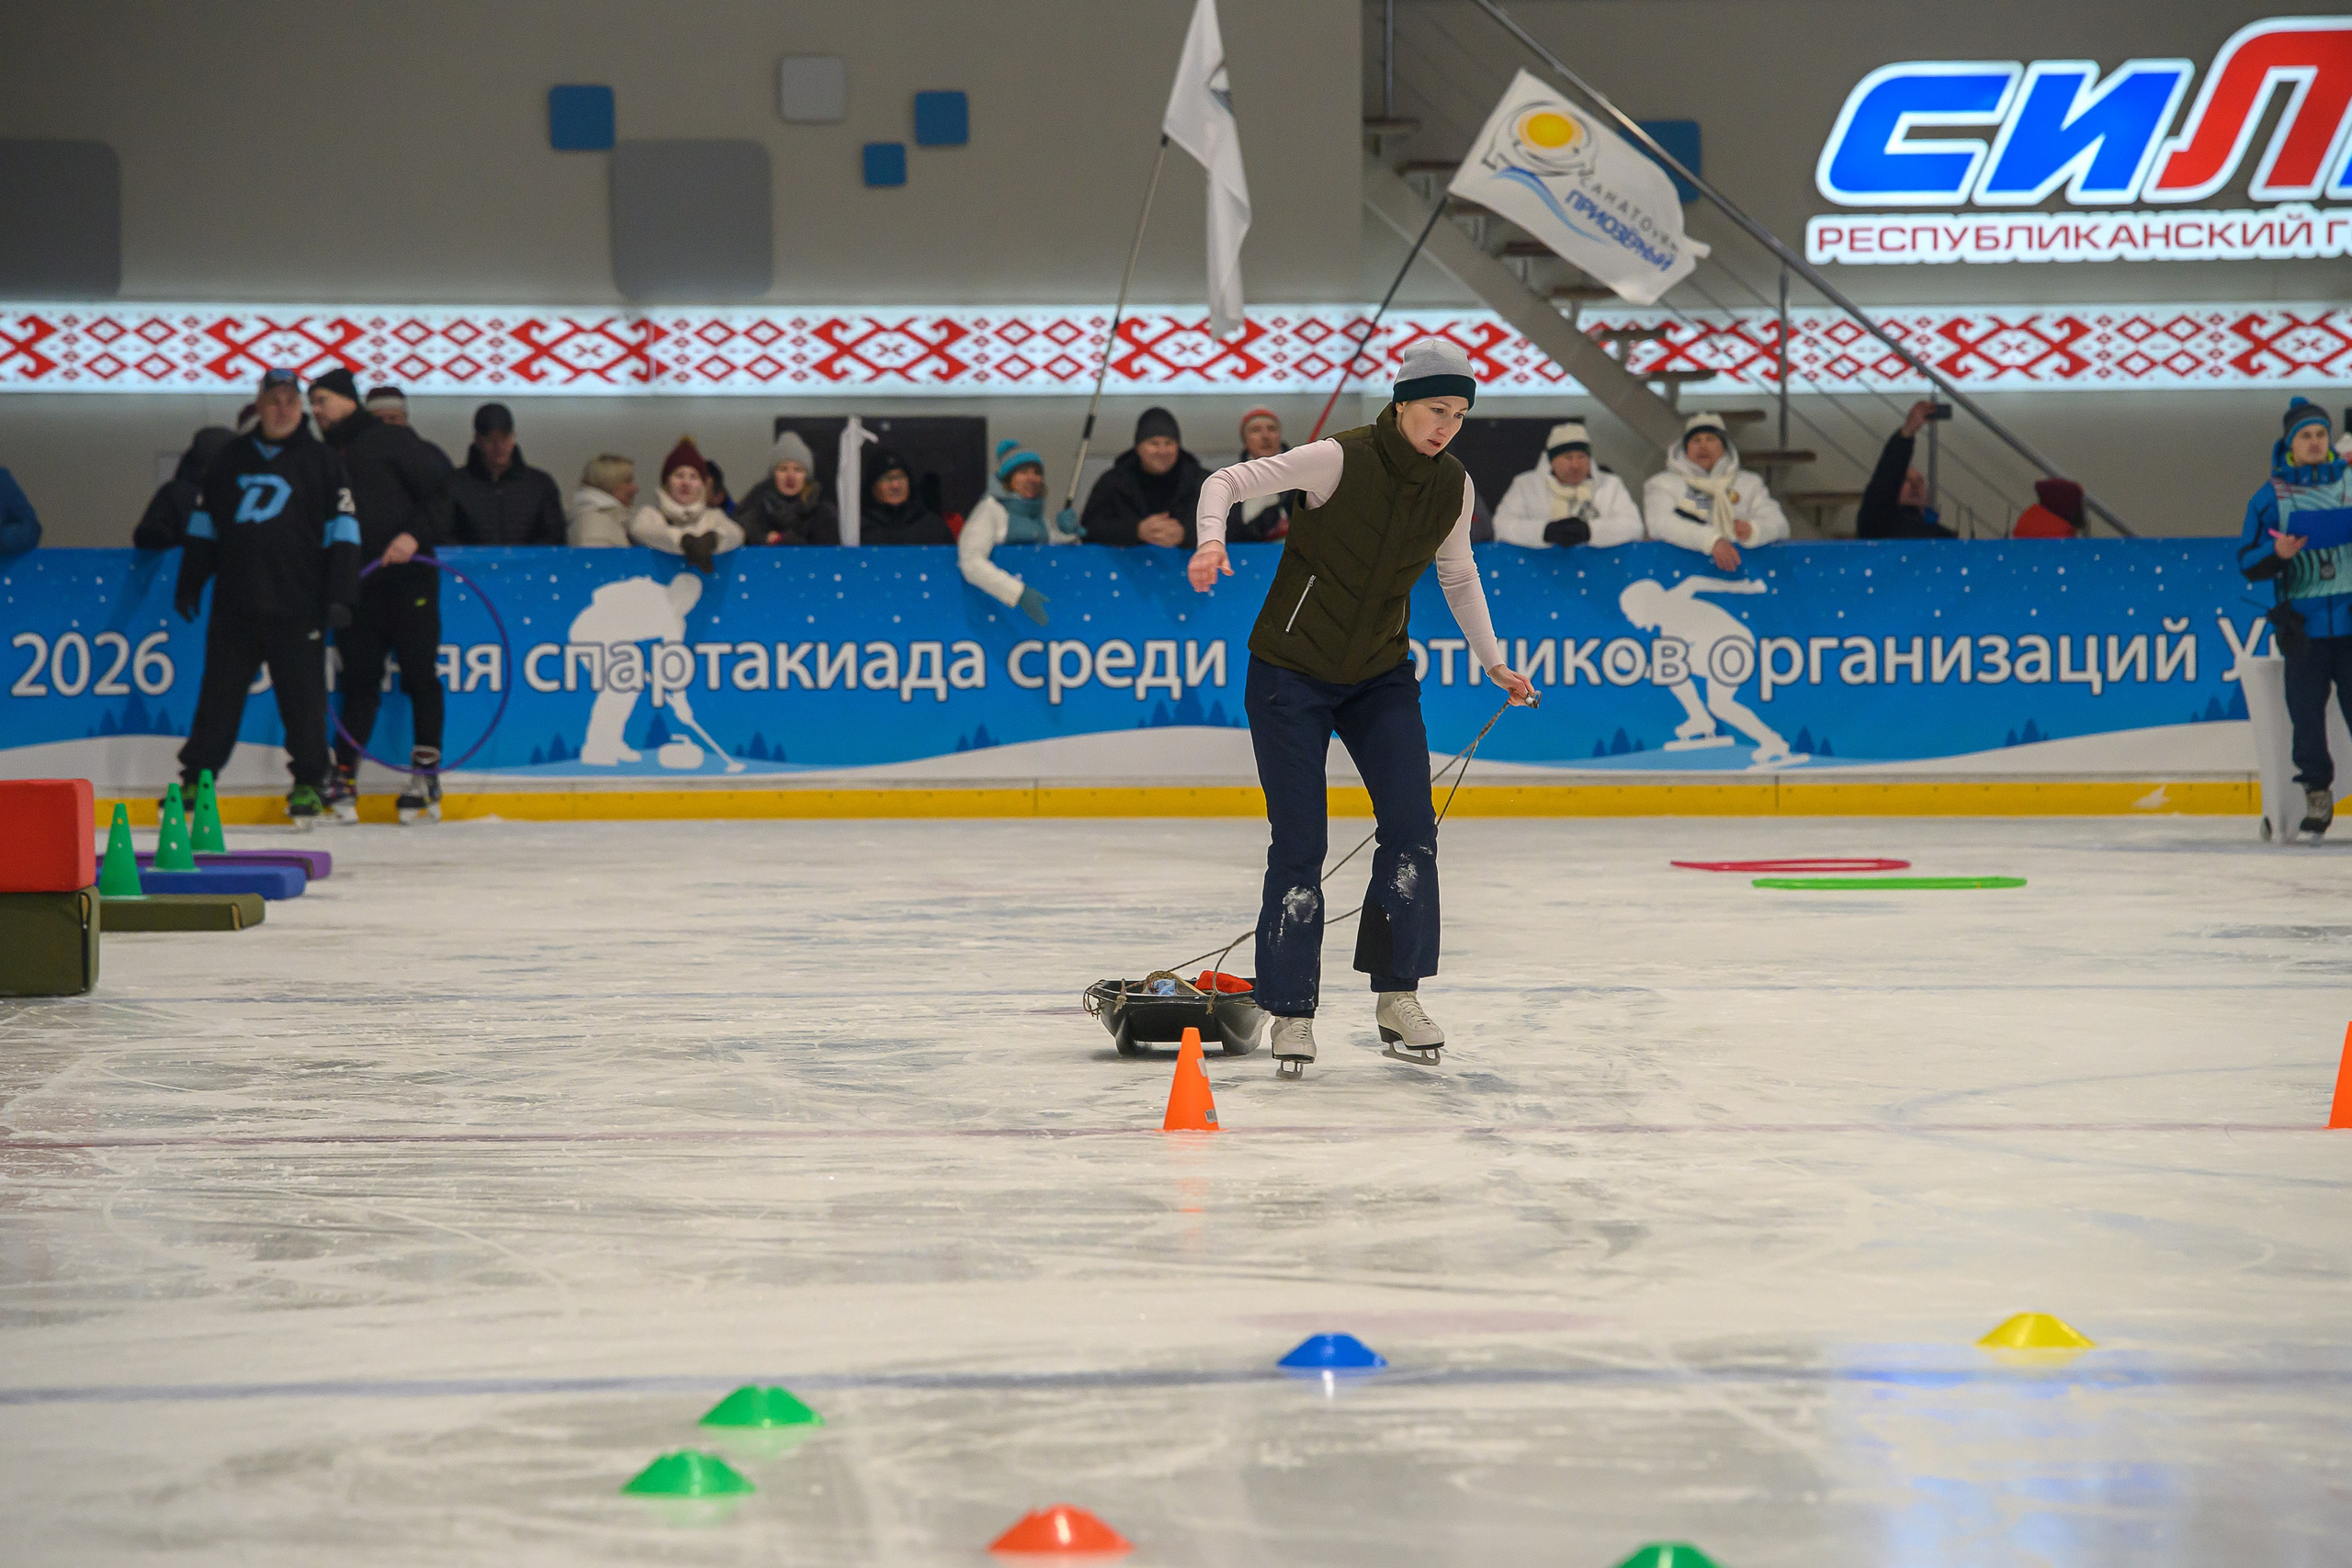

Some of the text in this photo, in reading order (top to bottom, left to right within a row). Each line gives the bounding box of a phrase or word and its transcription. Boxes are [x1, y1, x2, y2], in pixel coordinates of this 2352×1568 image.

[1816, 16, 2352, 206] СИЛ
[1817, 211, 2352, 254] РЕСПУБЛИКАНСКИЙ Г
[10, 631, 175, 696] 2026
[523, 640, 987, 707] спартакиада
[1007, 638, 1227, 704] среди
[1707, 617, 2198, 703] организаций
[2217, 616, 2282, 682] У
